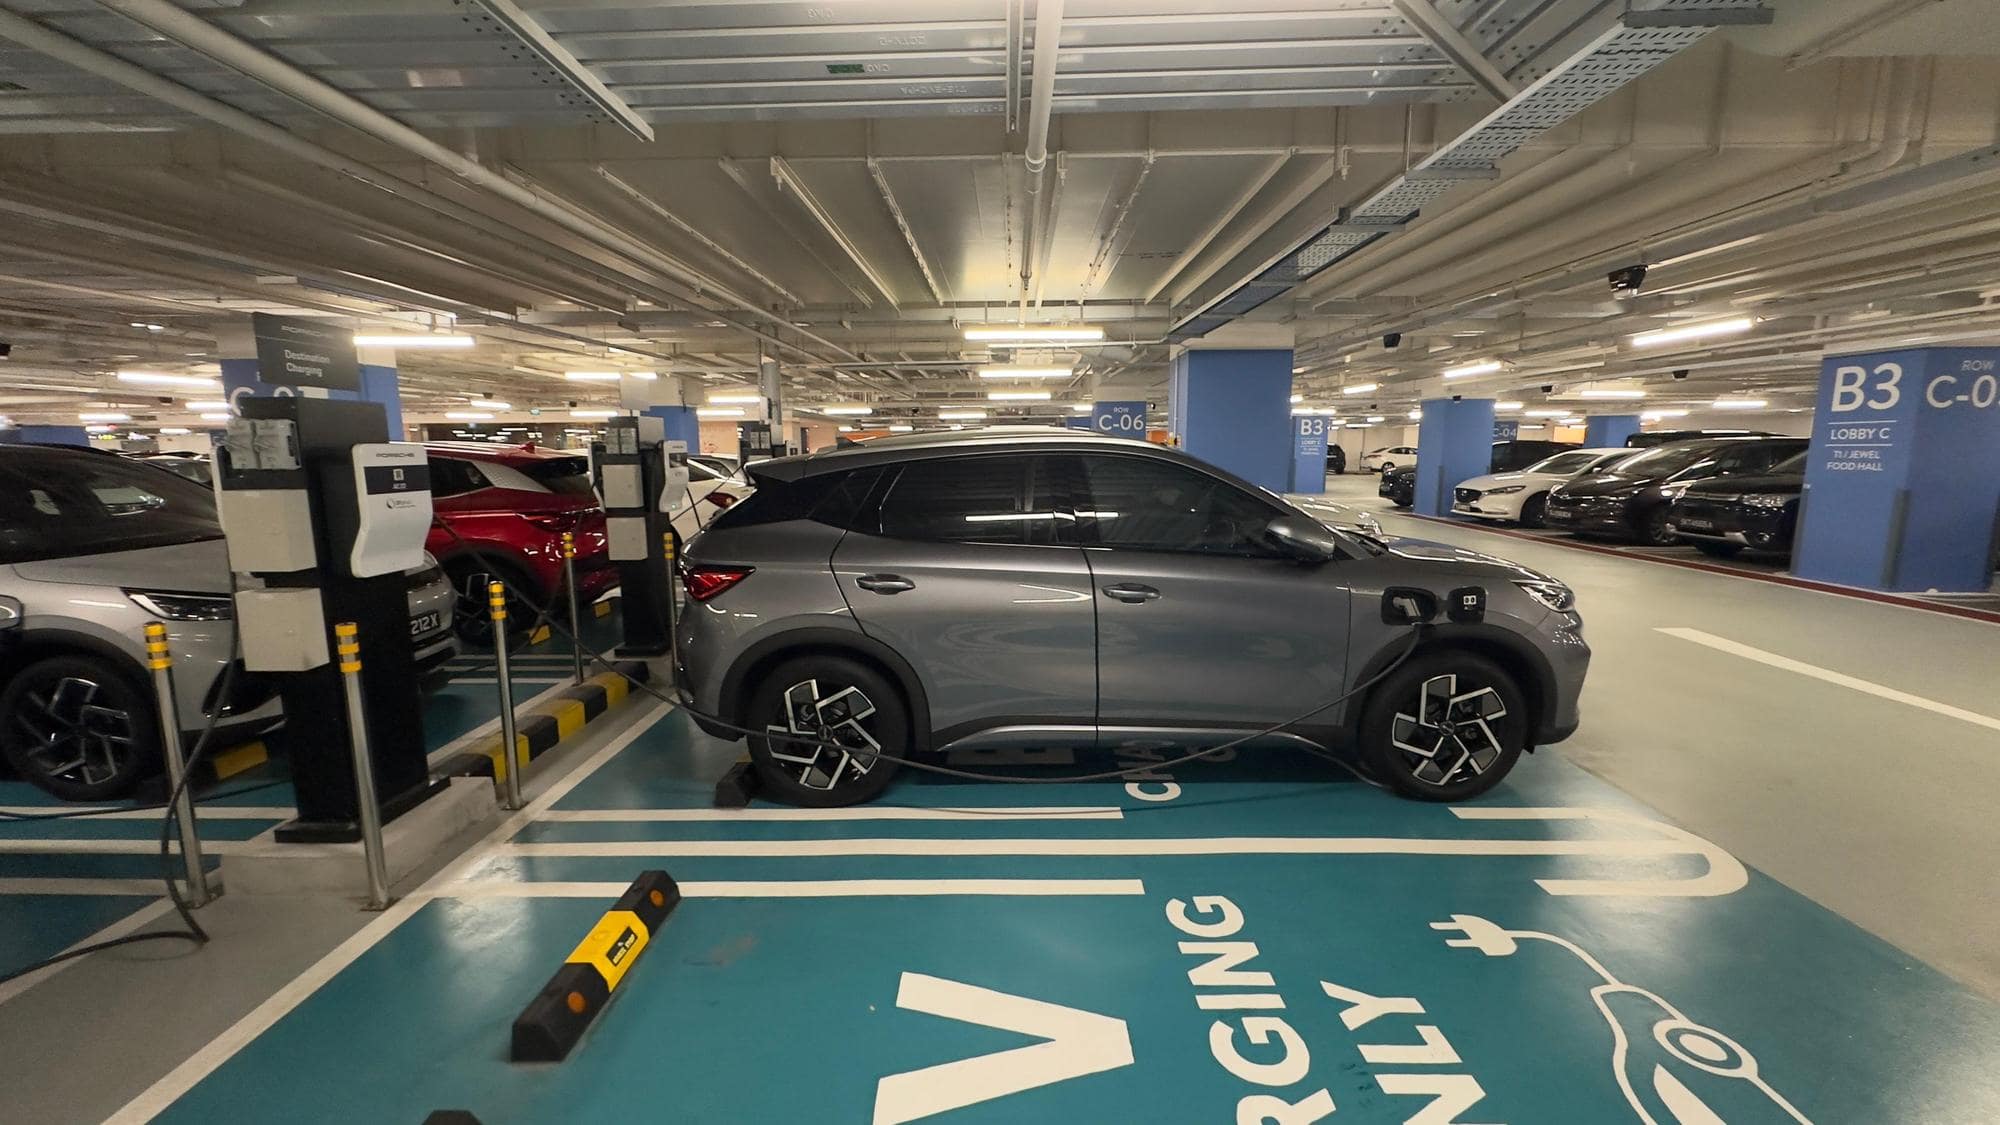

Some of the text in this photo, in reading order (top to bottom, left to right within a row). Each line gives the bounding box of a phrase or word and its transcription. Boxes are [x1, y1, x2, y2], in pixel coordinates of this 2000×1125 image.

[284, 349, 330, 364] Destination
[286, 362, 323, 378] Charging
[1961, 360, 1995, 371] ROW
[1831, 363, 1902, 412] B3
[1926, 375, 2000, 408] C-0
[1099, 414, 1144, 431] C-06
[1301, 418, 1324, 436] B3
[1831, 427, 1891, 440] LOBBY C
[1848, 450, 1881, 460] JEWEL
[1826, 461, 1884, 472] FOOD HALL
[410, 612, 439, 635] 212X
[872, 971, 1136, 1125] V
